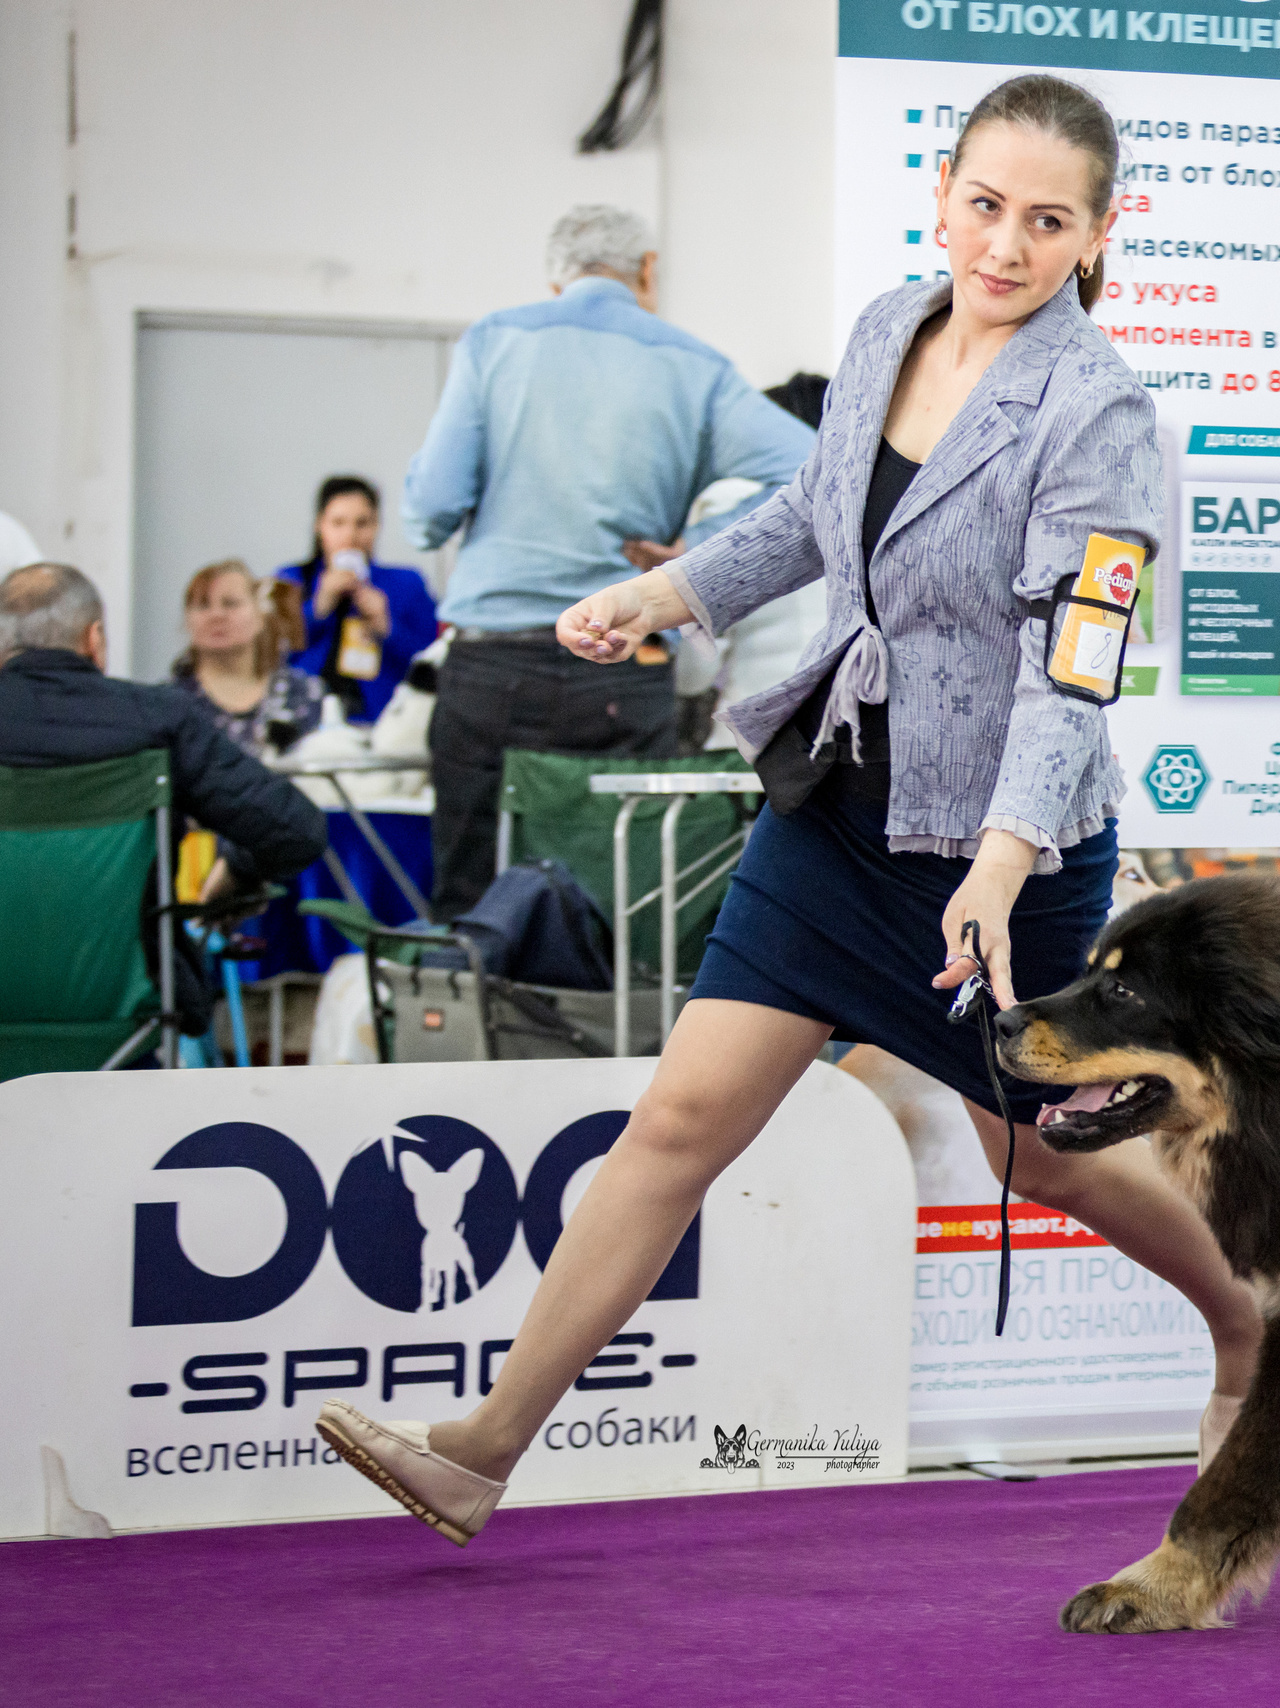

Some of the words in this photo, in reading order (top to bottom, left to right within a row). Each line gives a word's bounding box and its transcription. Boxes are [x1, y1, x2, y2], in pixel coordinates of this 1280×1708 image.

[901, 0, 960, 30] ОТ
[968, 2, 1082, 37] БЛОХ
[1088, 8, 1118, 39] И
[1117, 118, 1191, 142] идов
[1181, 165, 1213, 184] от
[1133, 282, 1218, 306] укуса
[1263, 331, 1278, 349] в
[1137, 370, 1213, 391] щита
[1220, 372, 1258, 394] до
[1204, 433, 1236, 448] ДЛЯ
[1092, 566, 1136, 593] Pedigr
[1090, 632, 1113, 670] 8
[126, 1436, 342, 1478] вселенна
[544, 1406, 697, 1452] собаки
